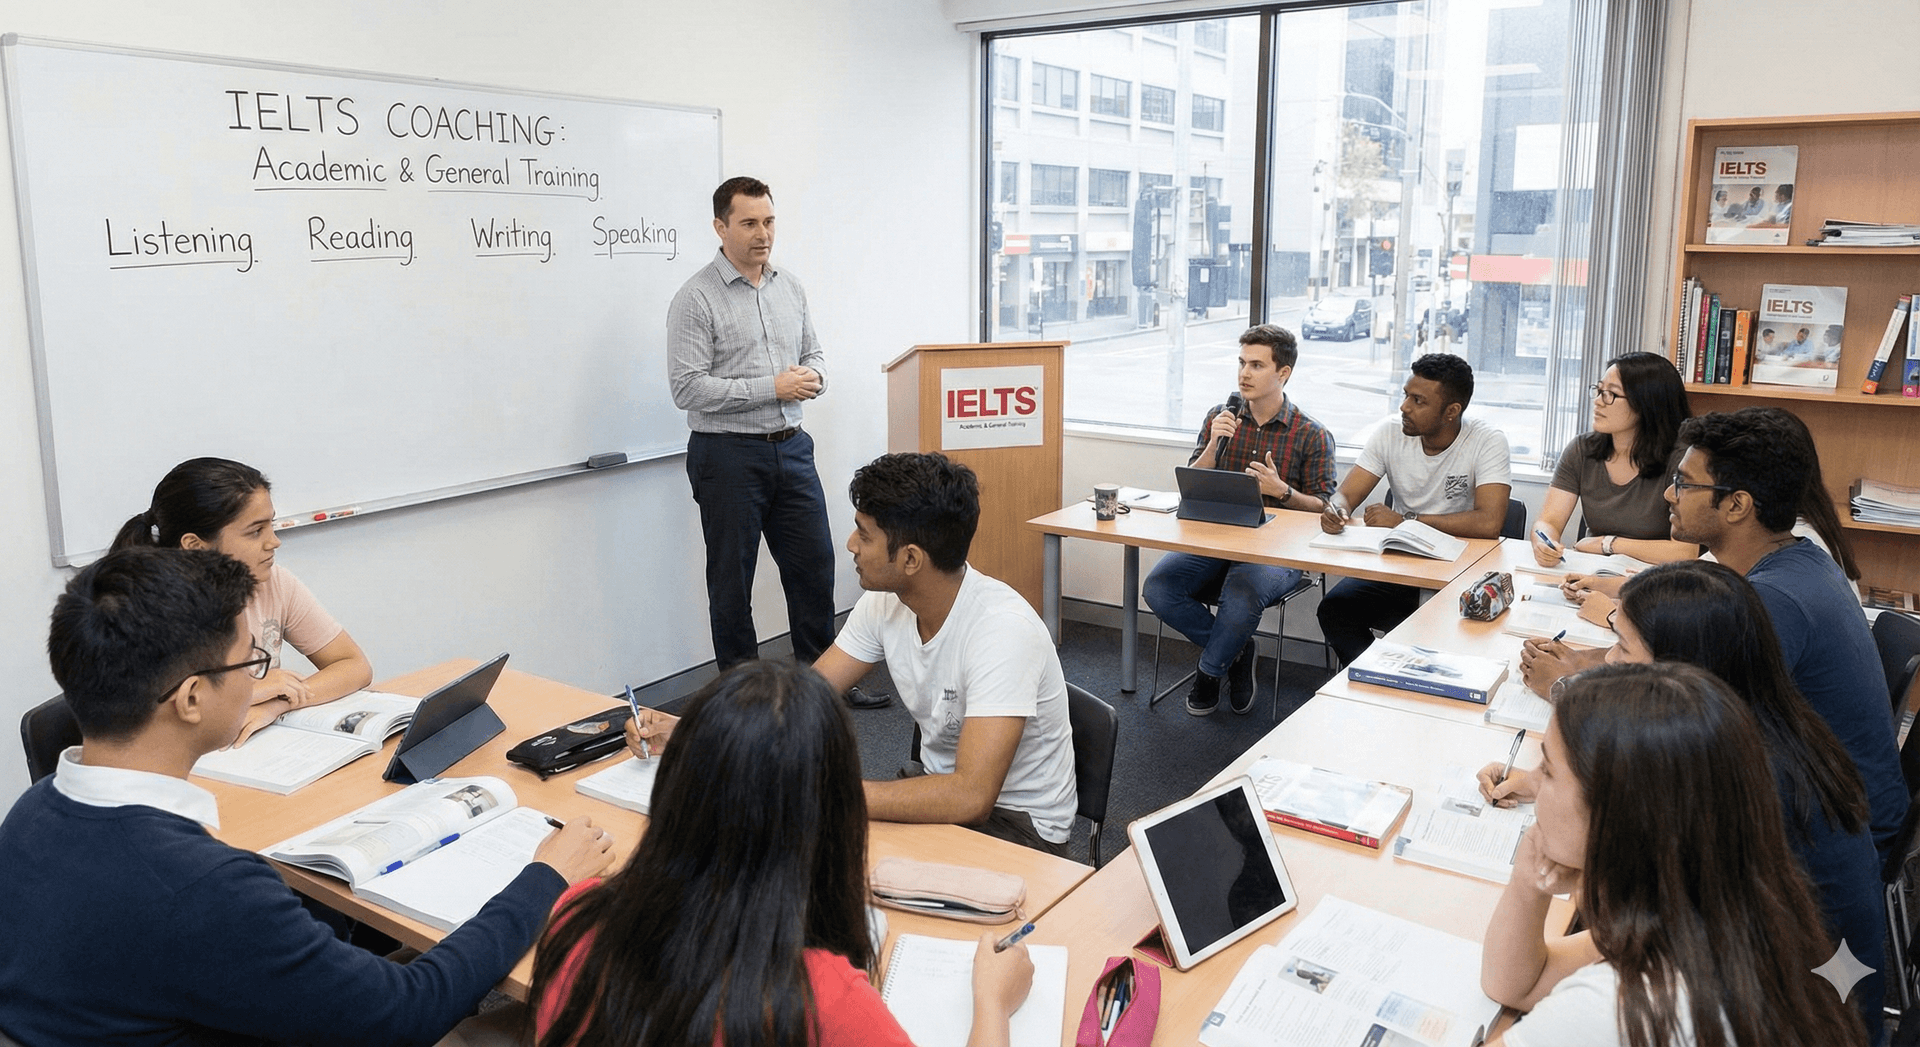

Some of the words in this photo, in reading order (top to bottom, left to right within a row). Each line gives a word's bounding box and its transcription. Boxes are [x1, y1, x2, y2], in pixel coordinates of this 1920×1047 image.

[225, 90, 359, 136] IELTS
[387, 102, 566, 146] COACHING:
[253, 146, 388, 182] Academic
[399, 157, 415, 183] &
[425, 153, 510, 185] General
[1720, 161, 1767, 175] IELTS
[1766, 298, 1814, 314] IELTS
[947, 386, 1037, 418] IELTS
